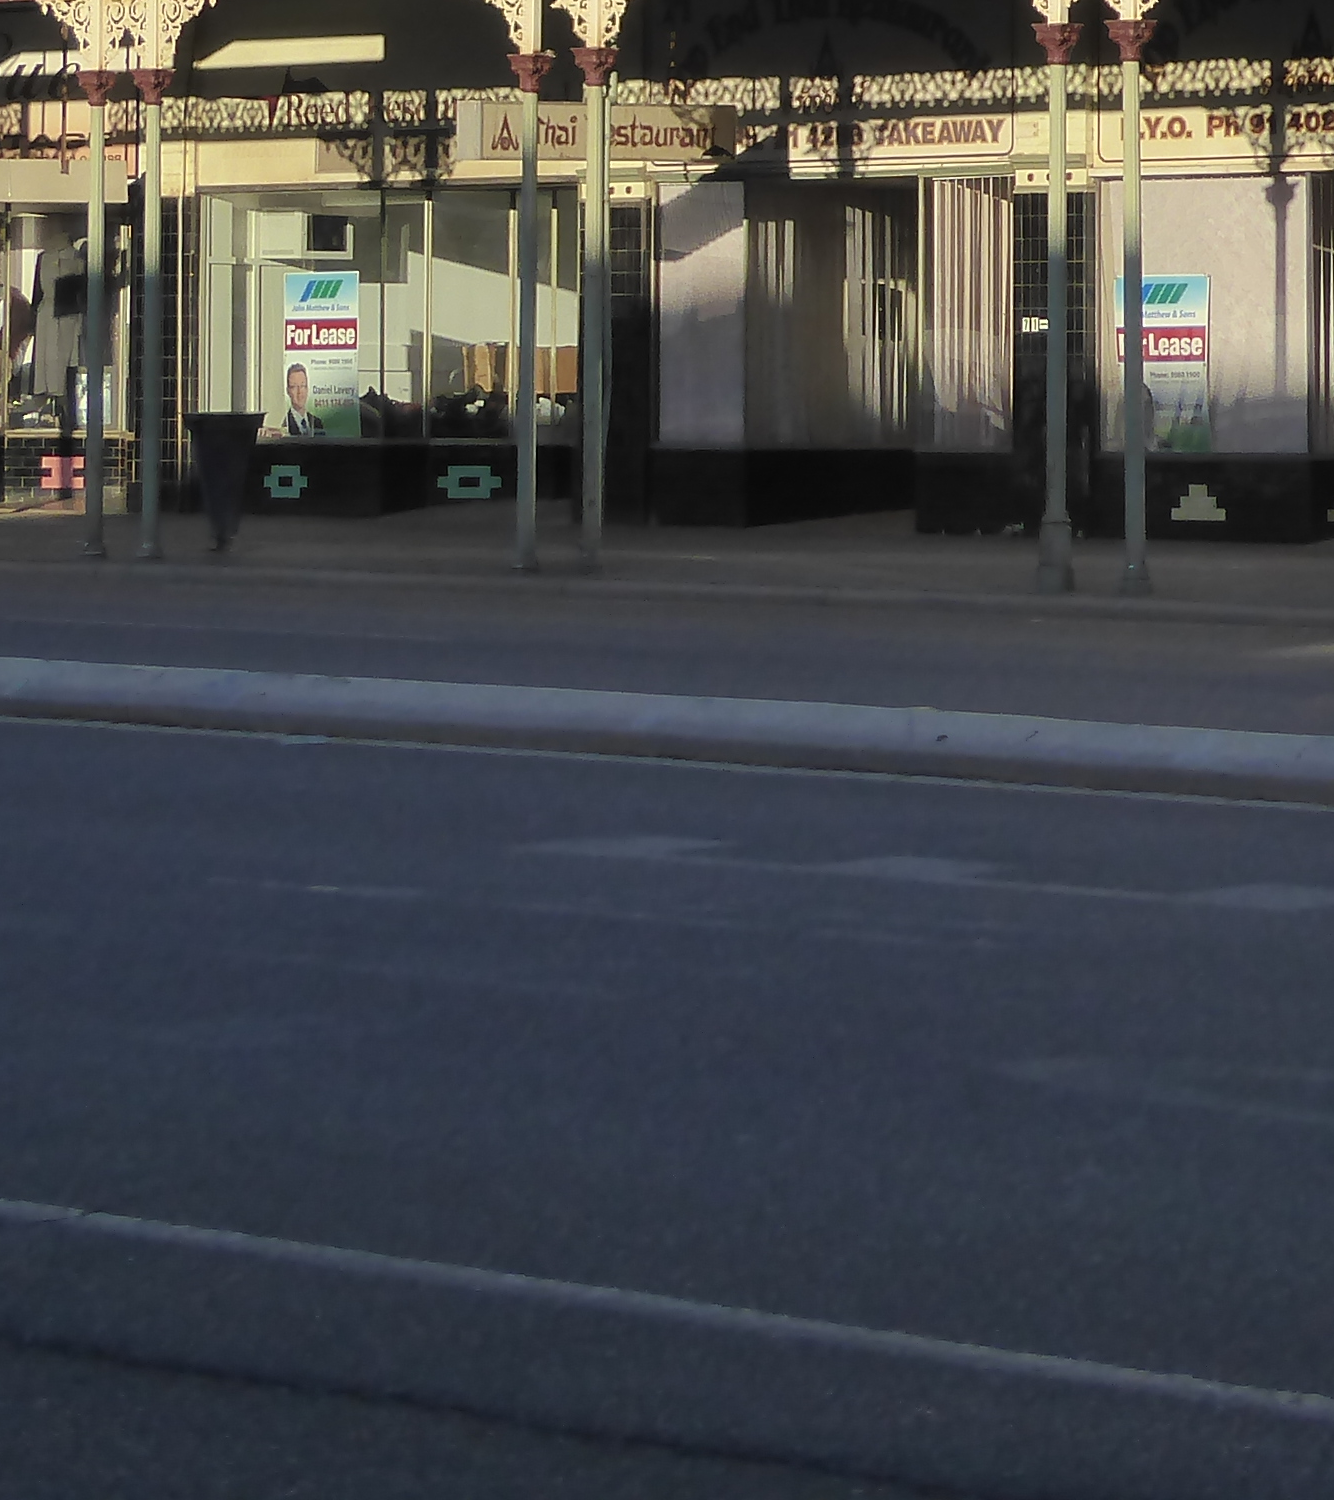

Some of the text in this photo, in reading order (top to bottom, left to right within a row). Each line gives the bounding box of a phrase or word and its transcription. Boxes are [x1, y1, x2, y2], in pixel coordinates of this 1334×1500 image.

[1121, 116, 1193, 140] .Y.O.
[286, 323, 356, 346] For Lease
[1148, 332, 1204, 356] Lease
